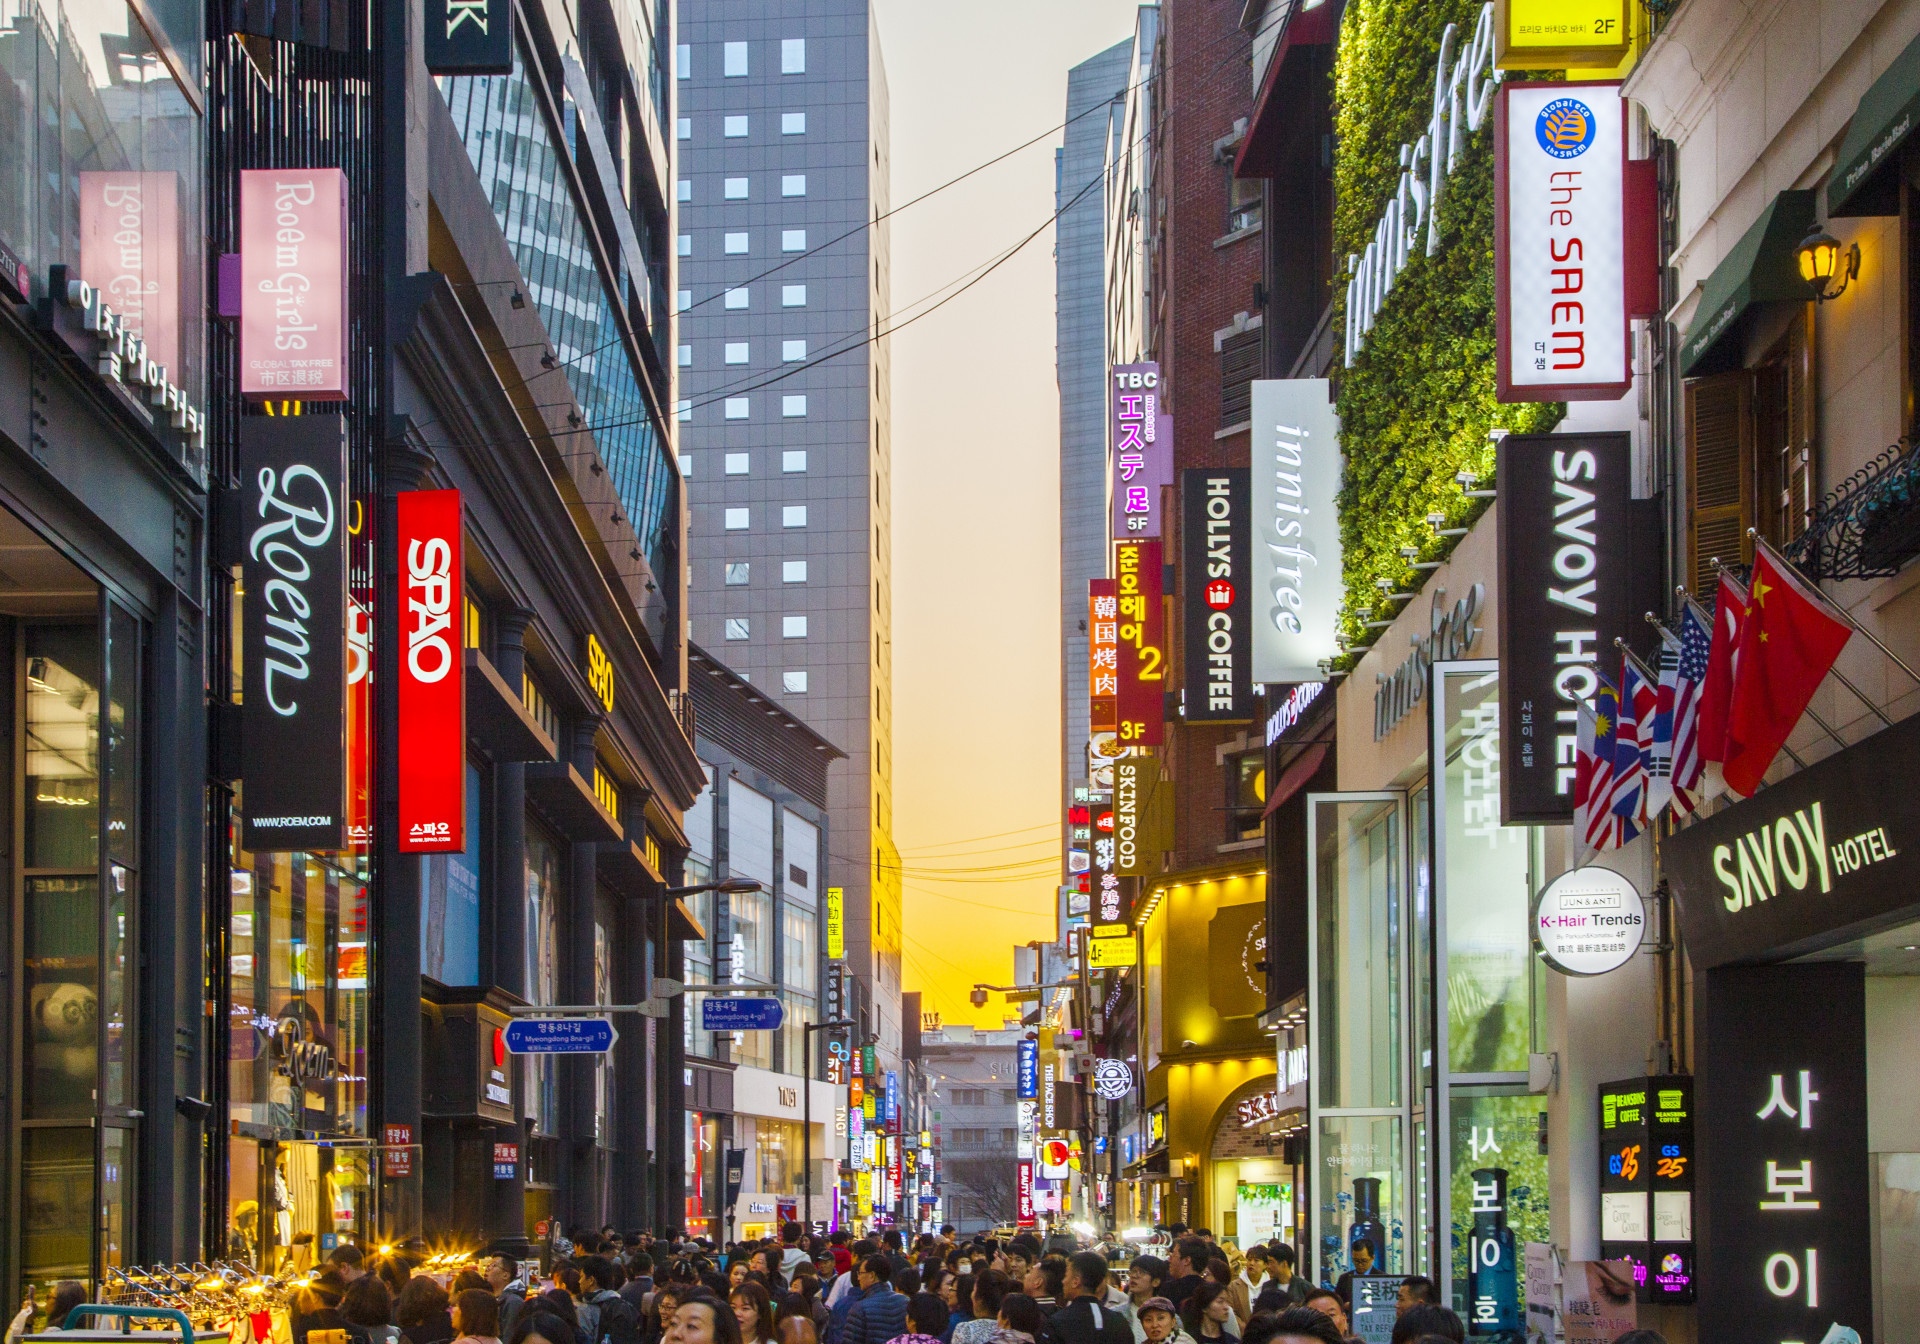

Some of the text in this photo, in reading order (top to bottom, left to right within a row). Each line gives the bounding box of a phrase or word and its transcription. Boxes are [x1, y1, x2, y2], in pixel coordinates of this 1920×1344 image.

[1519, 25, 1587, 34] 프리모 바치오 바치
[1594, 19, 1616, 33] 2F
[1540, 99, 1590, 118] global eco
[258, 180, 318, 350] Roem Girls
[1550, 171, 1586, 370] the SAEM
[250, 358, 333, 369] GLOBAL TAX FREE
[259, 369, 325, 386] 市区退税
[1115, 372, 1157, 389] TBC
[1118, 395, 1145, 481] エステ
[1127, 517, 1148, 531] 5F
[1267, 424, 1318, 635] innisfree
[1548, 450, 1597, 616] SAVOY
[250, 464, 334, 716] Roem
[1119, 546, 1146, 649] 준오헤어
[1206, 478, 1233, 711] HOLLYS COFFEE
[408, 537, 452, 683] SPAO
[1119, 720, 1146, 740] 3F
[252, 816, 331, 828] WWW.ROEM.COM
[1119, 764, 1137, 869] SKINFOOD
[410, 822, 449, 836] 스파오
[1713, 801, 1897, 913] SAVOY HOTEL
[1540, 913, 1641, 928] K-Hair Trends
[1615, 930, 1626, 938] 4F
[1090, 944, 1103, 963] 4F
[705, 1001, 737, 1012] 명동4길
[705, 1013, 749, 1022] Myeongdong
[511, 1032, 521, 1041] 17
[538, 1022, 581, 1034] 명동8나길
[597, 1031, 608, 1040] 13
[525, 1035, 569, 1043] Myeongdong
[1045, 1064, 1053, 1083] THE
[835, 1104, 847, 1138] TNGT
[1045, 1107, 1054, 1129] SHOP
[1620, 1109, 1640, 1122] COFFEE
[1021, 1165, 1030, 1217] BEAUTY SHOP
[1756, 1070, 1820, 1309] 사보이
